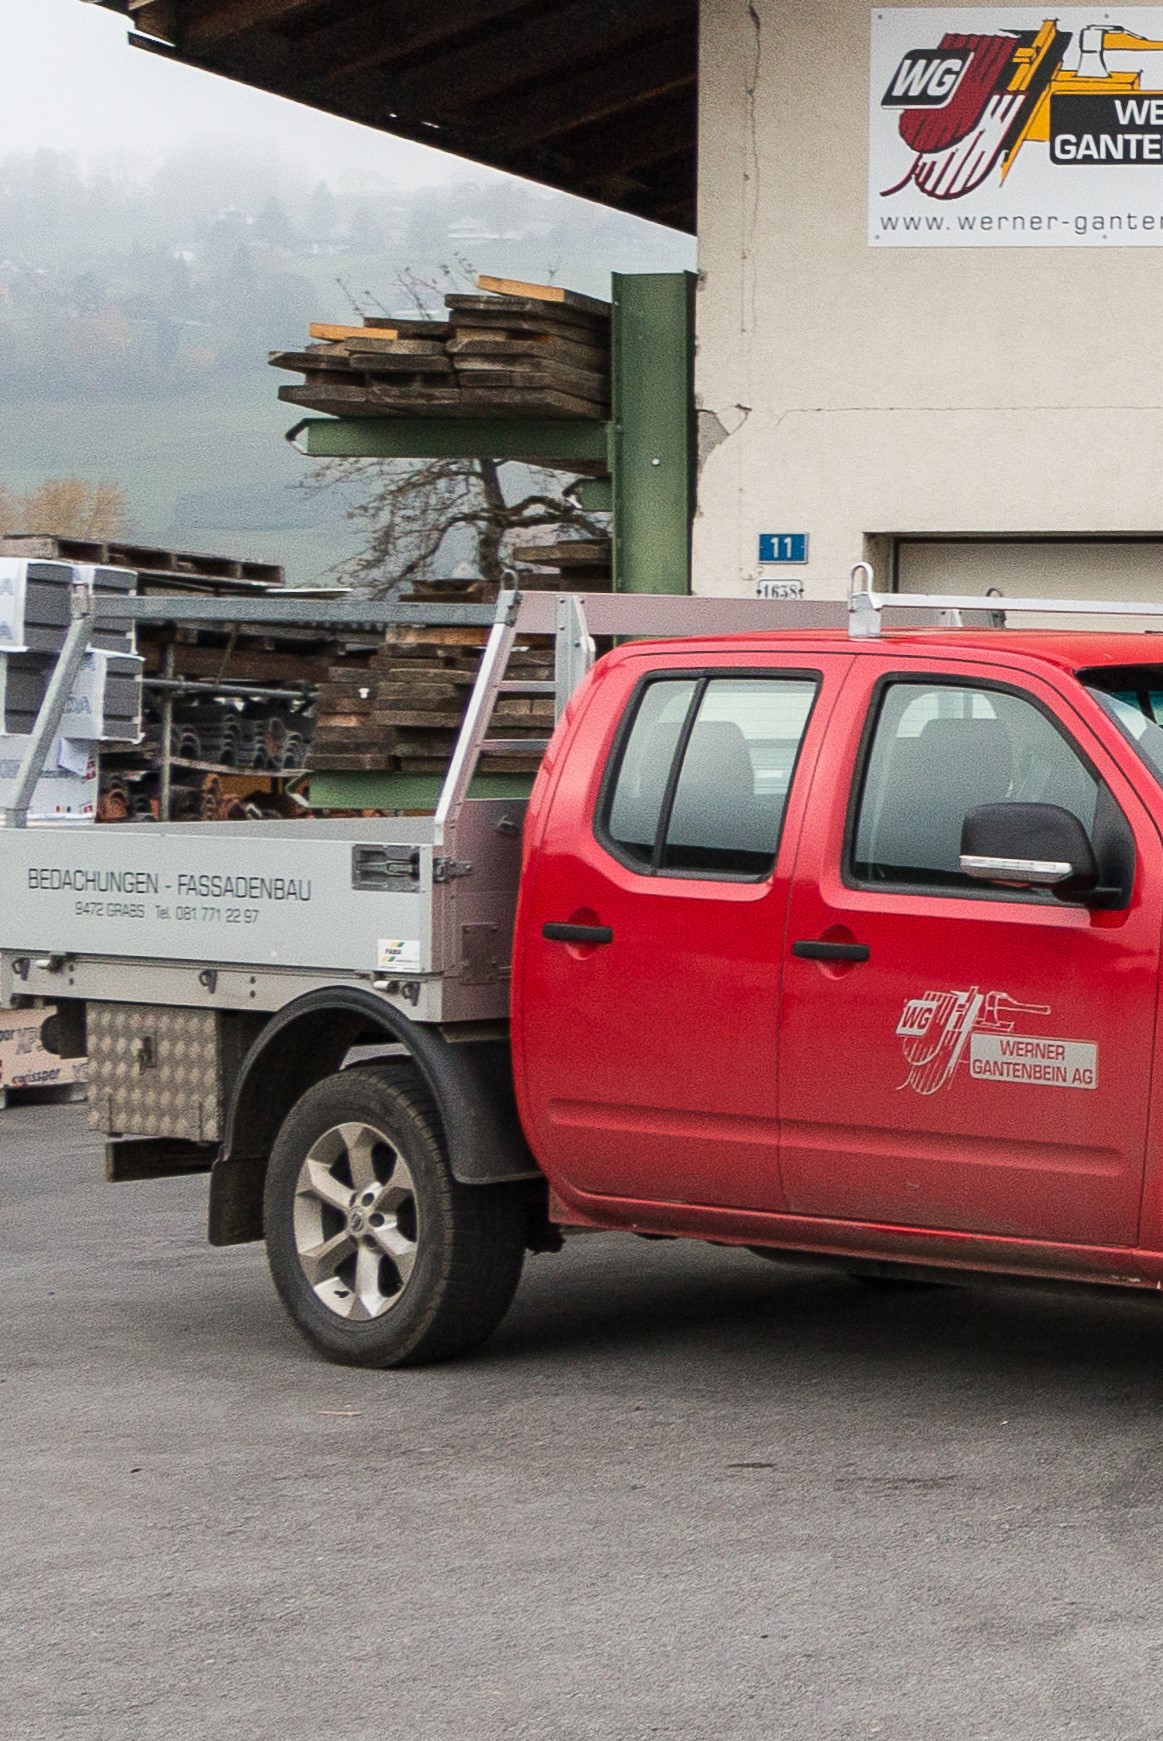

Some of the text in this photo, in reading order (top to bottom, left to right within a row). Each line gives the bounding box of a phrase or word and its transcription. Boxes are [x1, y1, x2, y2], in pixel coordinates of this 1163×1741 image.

[892, 58, 963, 97] WG
[770, 537, 792, 558] 11
[763, 584, 798, 600] 1638
[28, 868, 160, 894] BEDACHUNGEN
[177, 874, 311, 901] FASSADENBAU
[74, 901, 103, 917] 9472
[175, 905, 197, 921] 081
[202, 907, 221, 921] 771
[226, 907, 242, 923] 22
[244, 909, 259, 924] 97
[901, 1008, 932, 1030] WG
[1000, 1040, 1065, 1060] WERNER
[972, 1059, 1093, 1085] GANTENBEIN AG
